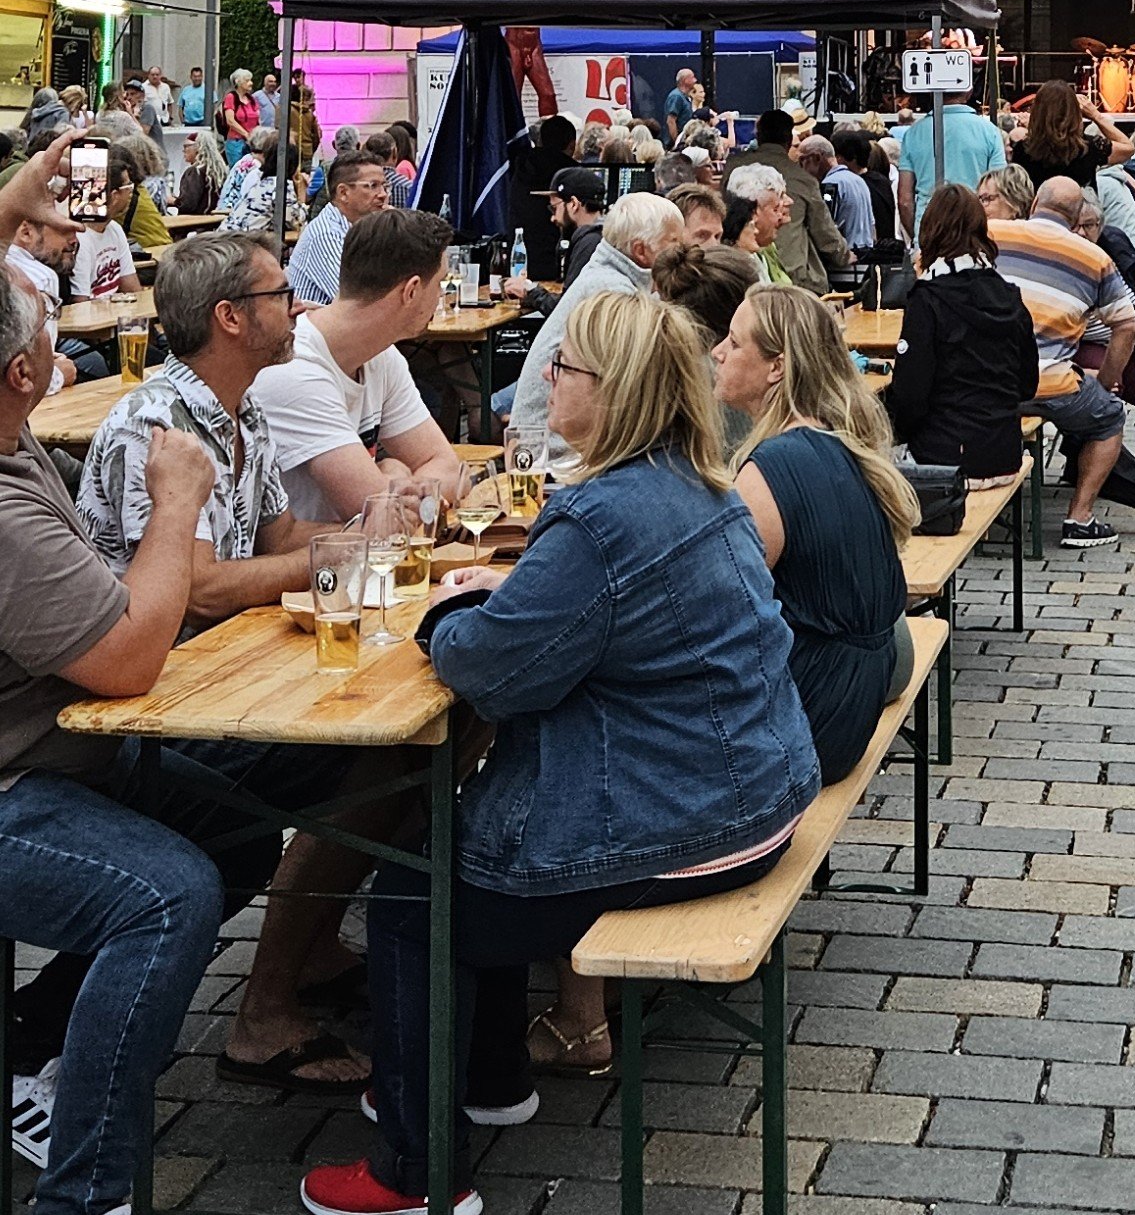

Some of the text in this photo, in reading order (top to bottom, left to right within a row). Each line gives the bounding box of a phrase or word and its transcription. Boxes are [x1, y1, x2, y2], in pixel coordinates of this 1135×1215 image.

[946, 55, 964, 66] WC
[430, 74, 450, 82] KU
[429, 82, 448, 90] SO
